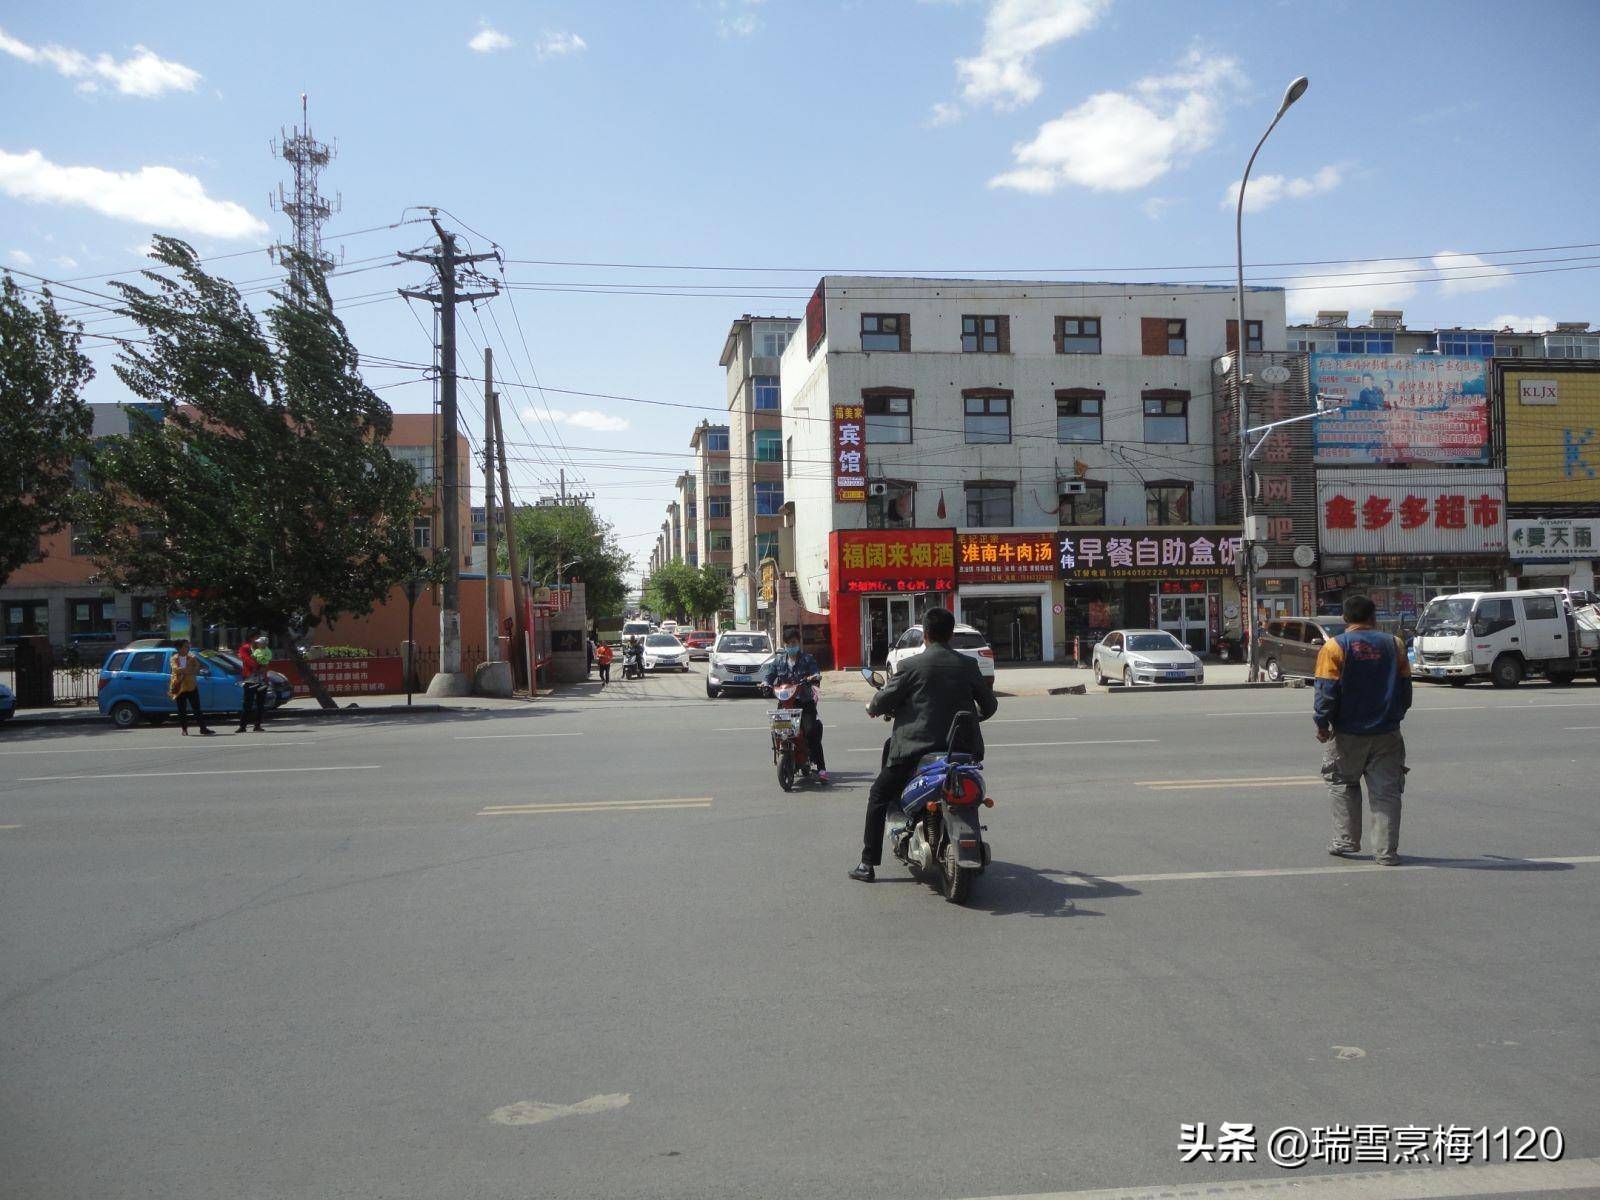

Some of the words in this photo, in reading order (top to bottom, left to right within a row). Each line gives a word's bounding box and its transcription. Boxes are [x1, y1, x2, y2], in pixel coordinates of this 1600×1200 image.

[1522, 386, 1557, 398] KLJX
[838, 423, 861, 473] 宾馆
[1325, 494, 1501, 530] 鑫多多超市
[843, 541, 954, 569] 福阔来烟酒
[962, 542, 1052, 562] 淮南牛肉汤
[1060, 537, 1075, 569] 大伟
[1077, 537, 1242, 568] 早餐自助盒饭
